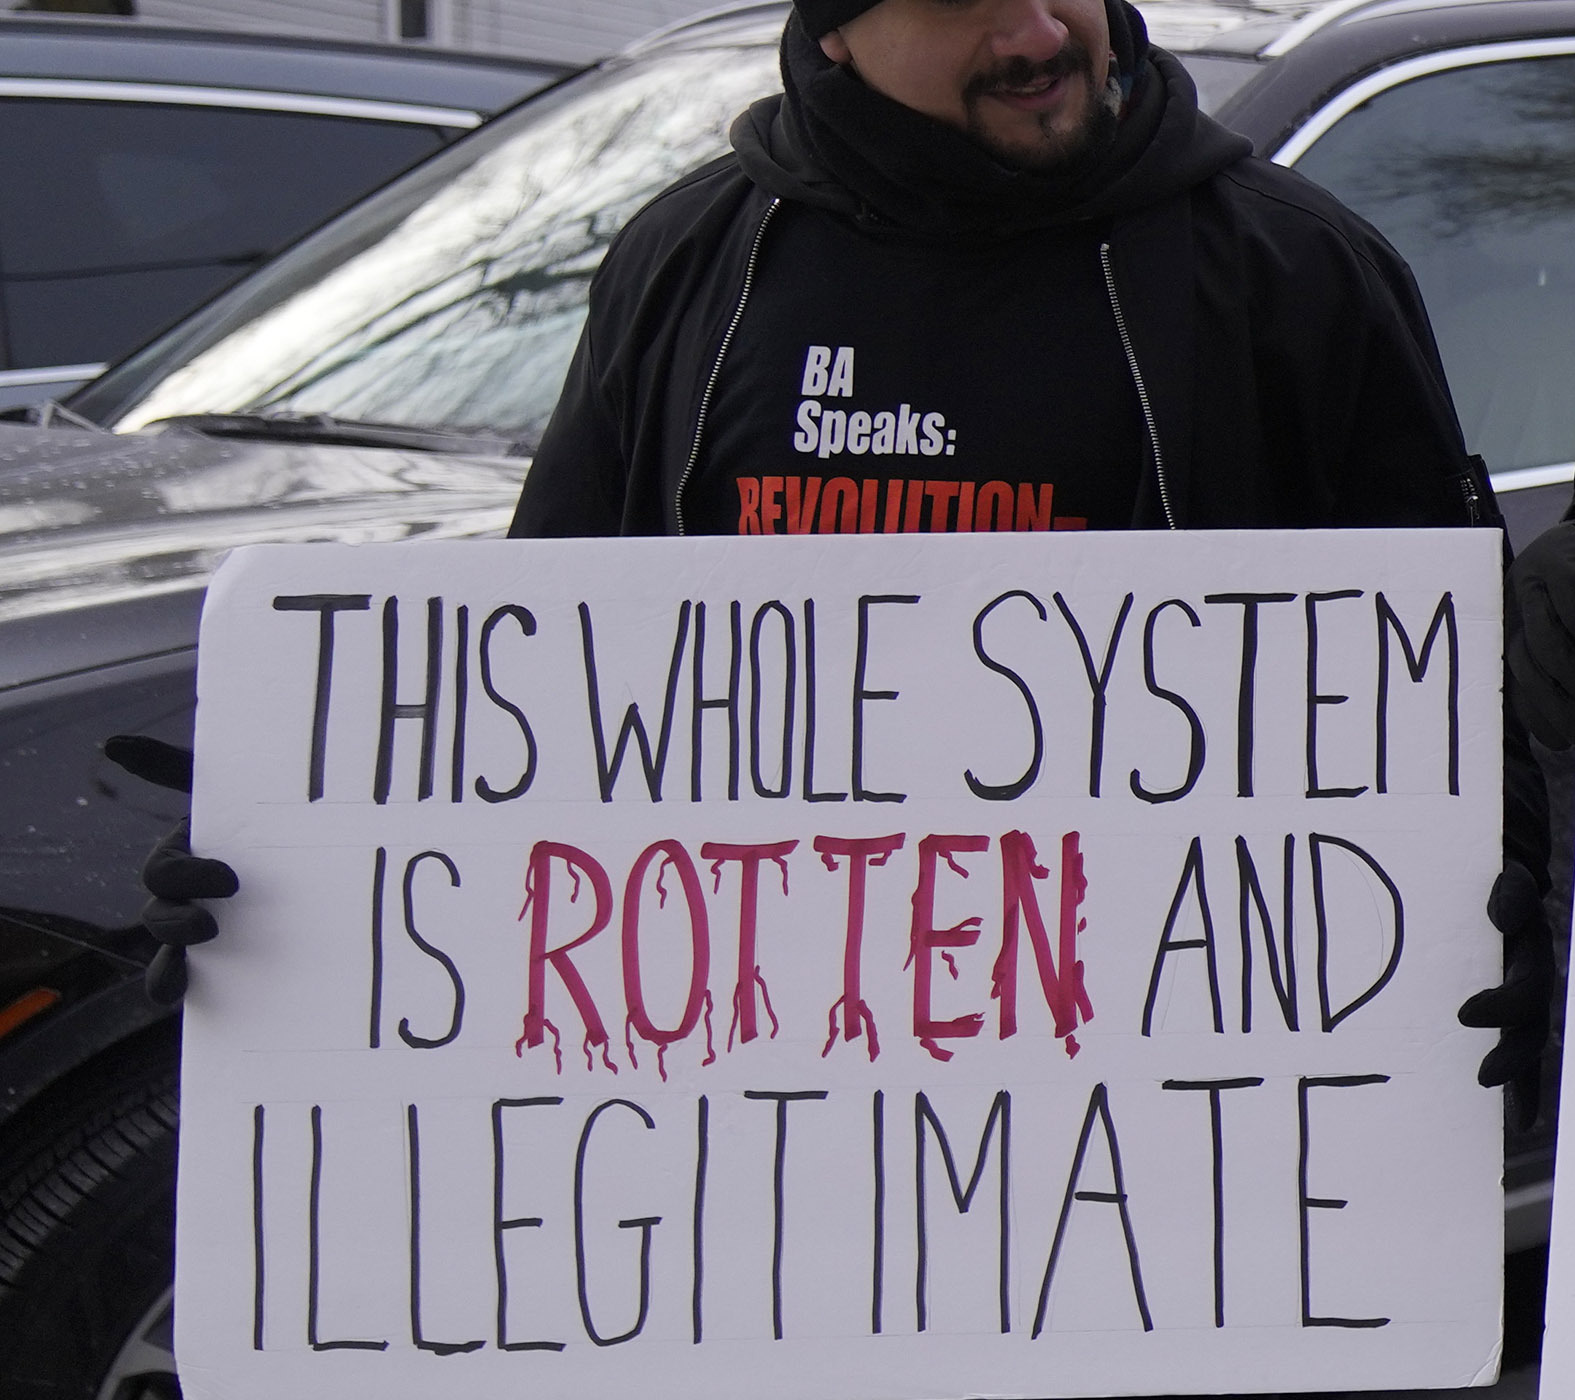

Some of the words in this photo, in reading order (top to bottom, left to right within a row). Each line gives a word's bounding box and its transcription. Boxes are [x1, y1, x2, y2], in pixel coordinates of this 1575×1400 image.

[794, 400, 956, 459] Speaks:
[801, 346, 854, 397] BA
[274, 593, 539, 804] THIS
[578, 593, 922, 804] WHOLE
[963, 587, 1460, 804] SYSTEM
[369, 845, 466, 1051] IS
[514, 828, 1094, 1082] ROTTEN
[1140, 832, 1406, 1039] AND
[252, 1073, 1392, 1356] ILLEGITIMATE
